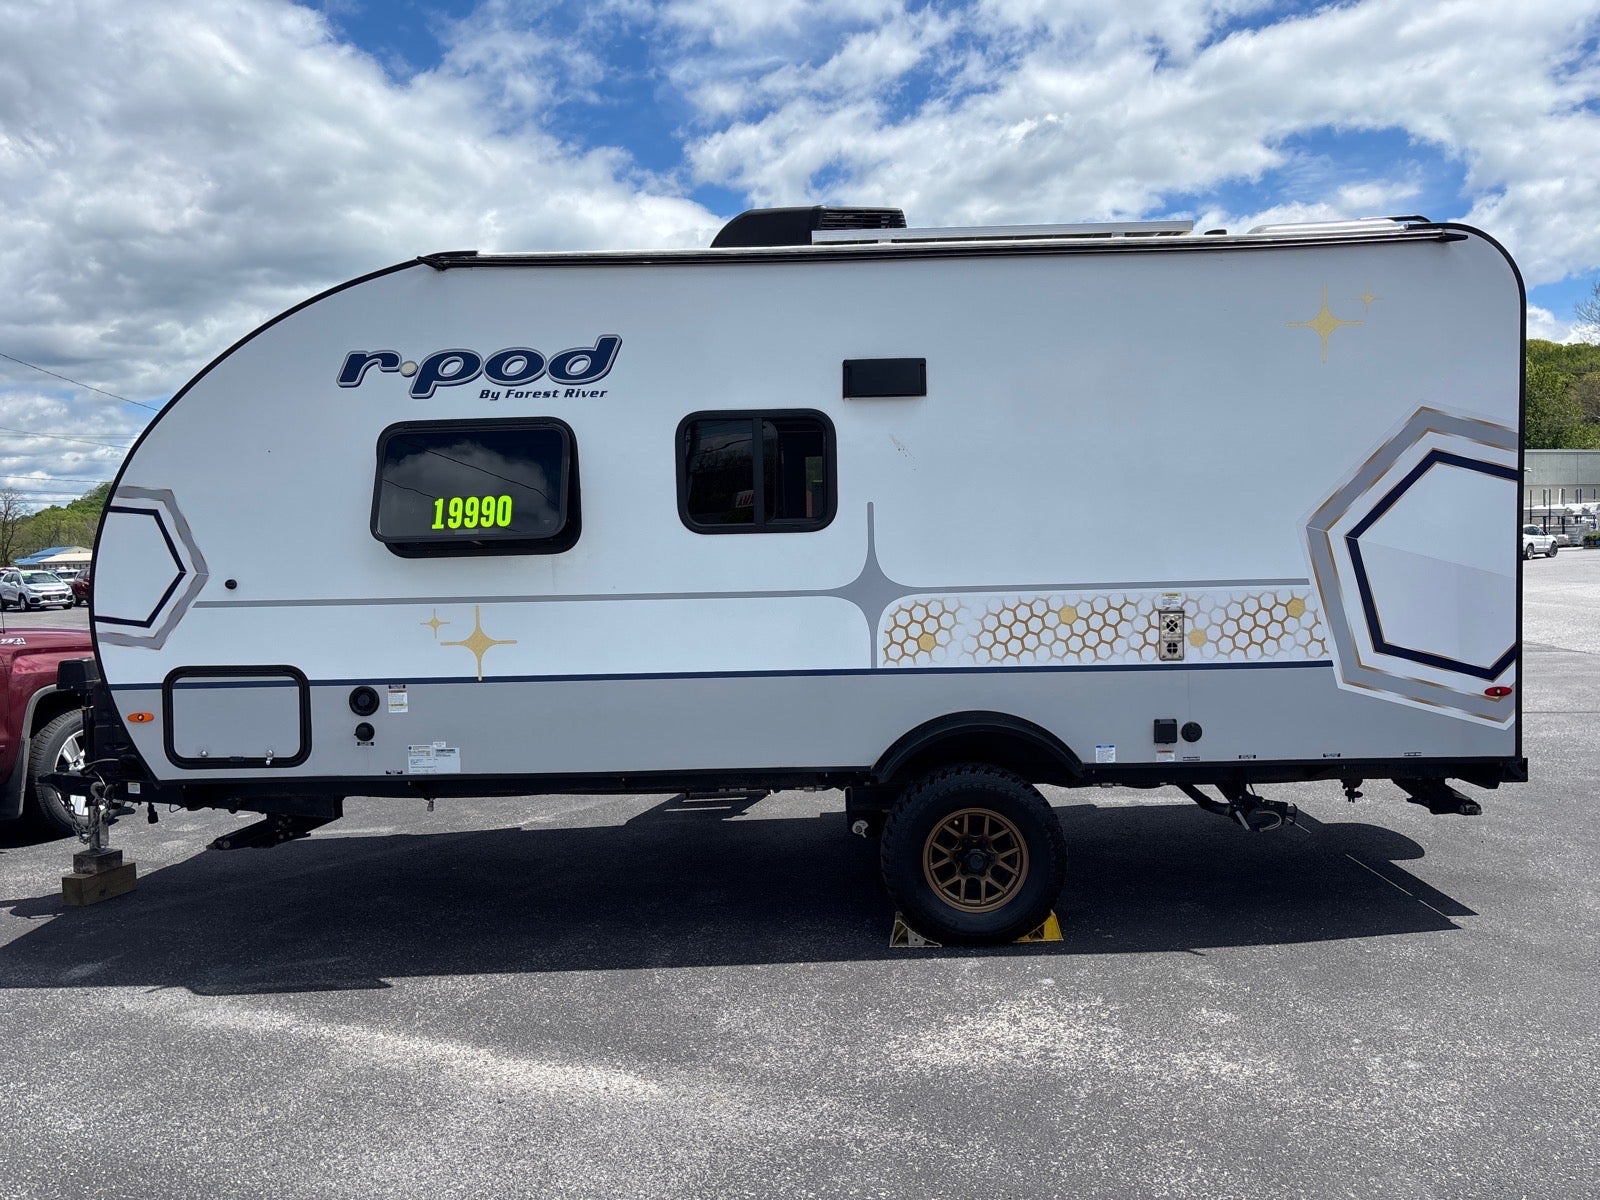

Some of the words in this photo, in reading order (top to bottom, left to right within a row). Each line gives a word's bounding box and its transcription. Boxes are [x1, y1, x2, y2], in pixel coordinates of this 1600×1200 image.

[479, 389, 500, 401] By
[505, 388, 559, 399] Forest
[564, 388, 608, 398] River
[431, 495, 513, 530] 19990
